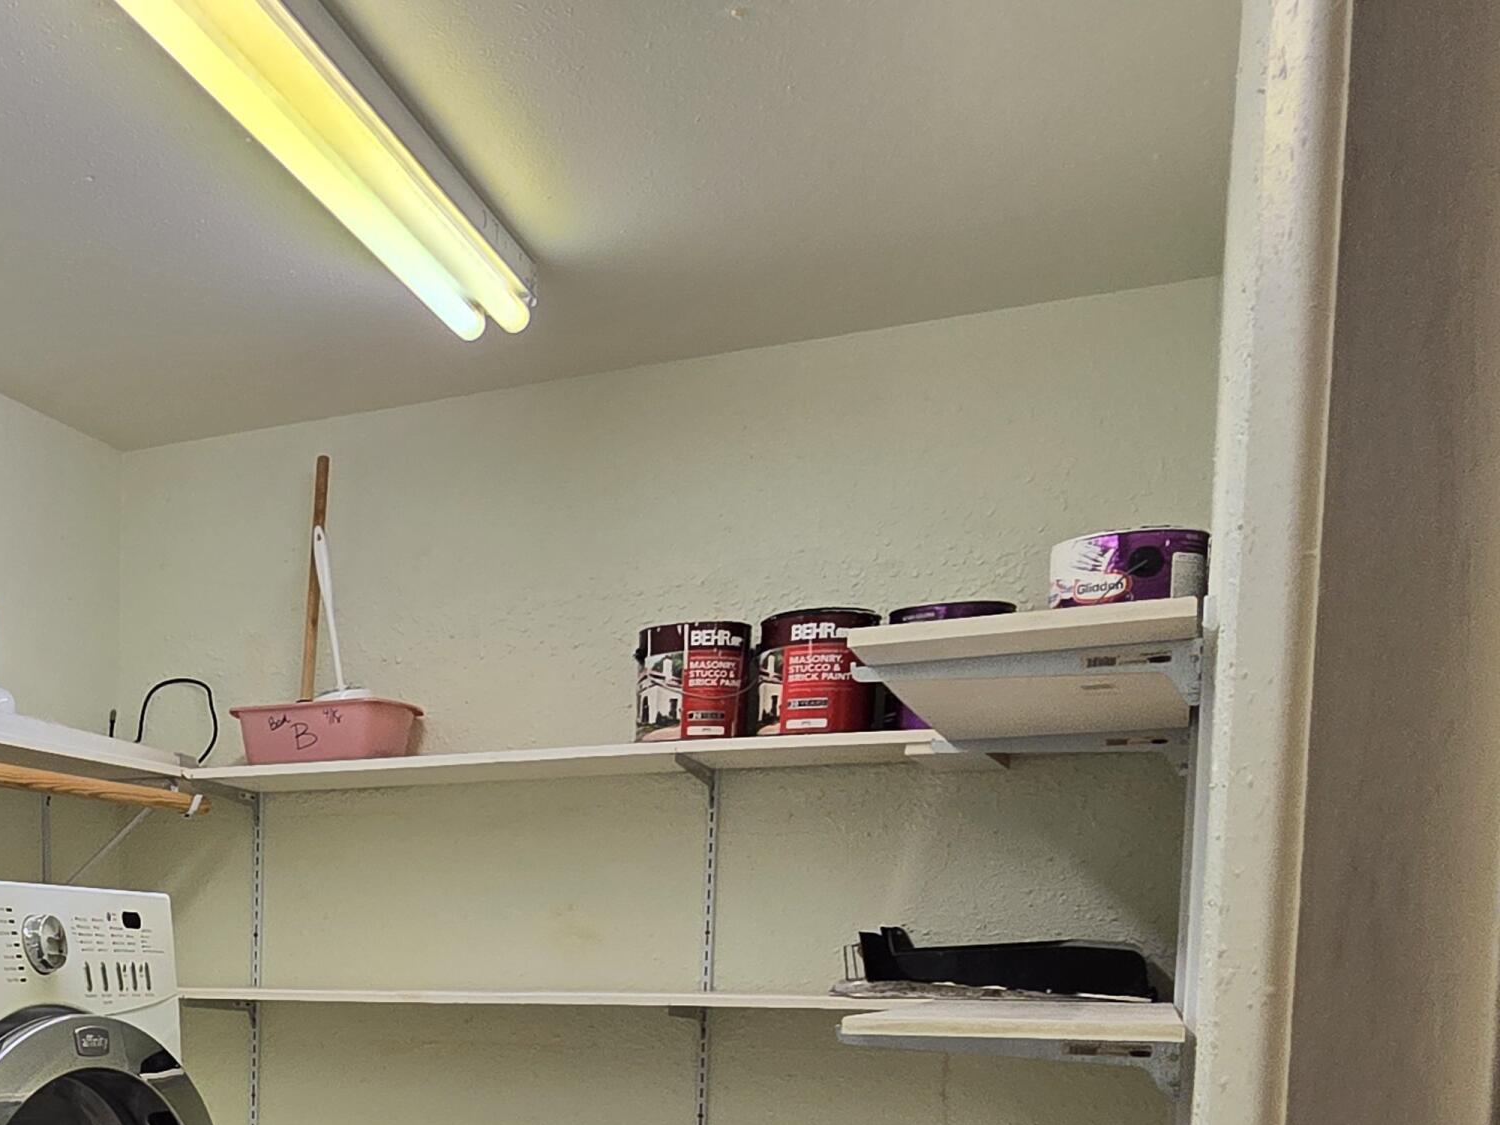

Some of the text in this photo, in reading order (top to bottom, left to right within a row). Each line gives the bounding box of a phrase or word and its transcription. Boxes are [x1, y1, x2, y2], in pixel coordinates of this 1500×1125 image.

[791, 622, 835, 641] BEHR
[691, 629, 731, 646] BEHR
[689, 670, 727, 678] STUCCO
[788, 664, 831, 674] STUCCO
[688, 678, 718, 687] BRICK
[788, 673, 819, 682] BRICK
[290, 722, 318, 750] B
